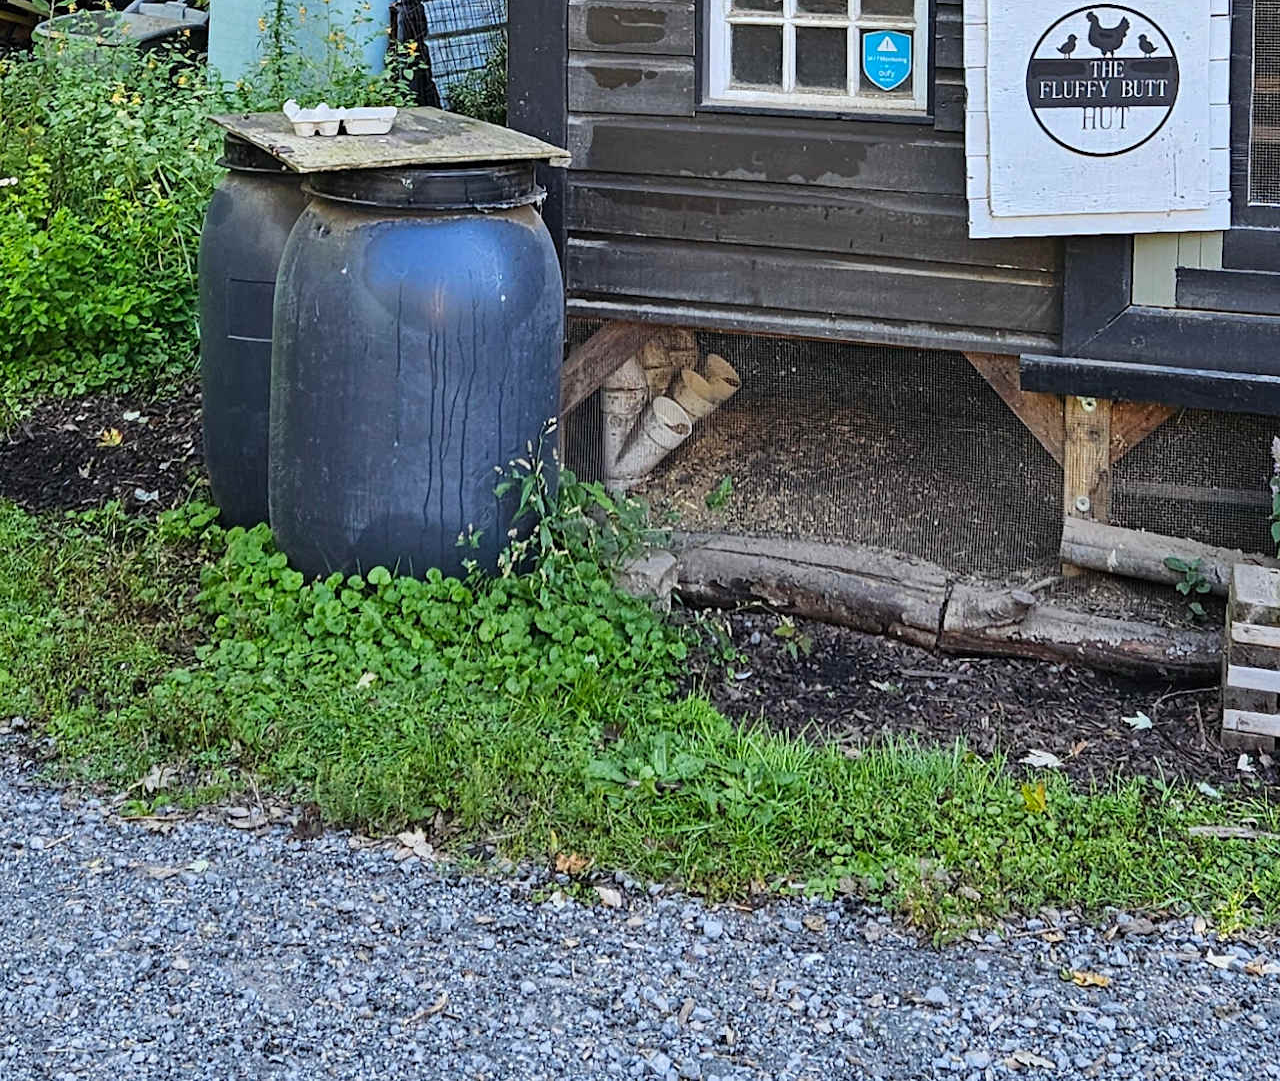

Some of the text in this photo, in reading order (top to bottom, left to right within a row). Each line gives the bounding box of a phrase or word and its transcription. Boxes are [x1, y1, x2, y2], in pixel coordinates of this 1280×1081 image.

[1090, 60, 1125, 78] THE
[1039, 79, 1169, 99] FLUFFY BUTT
[1082, 105, 1130, 130] HUT
